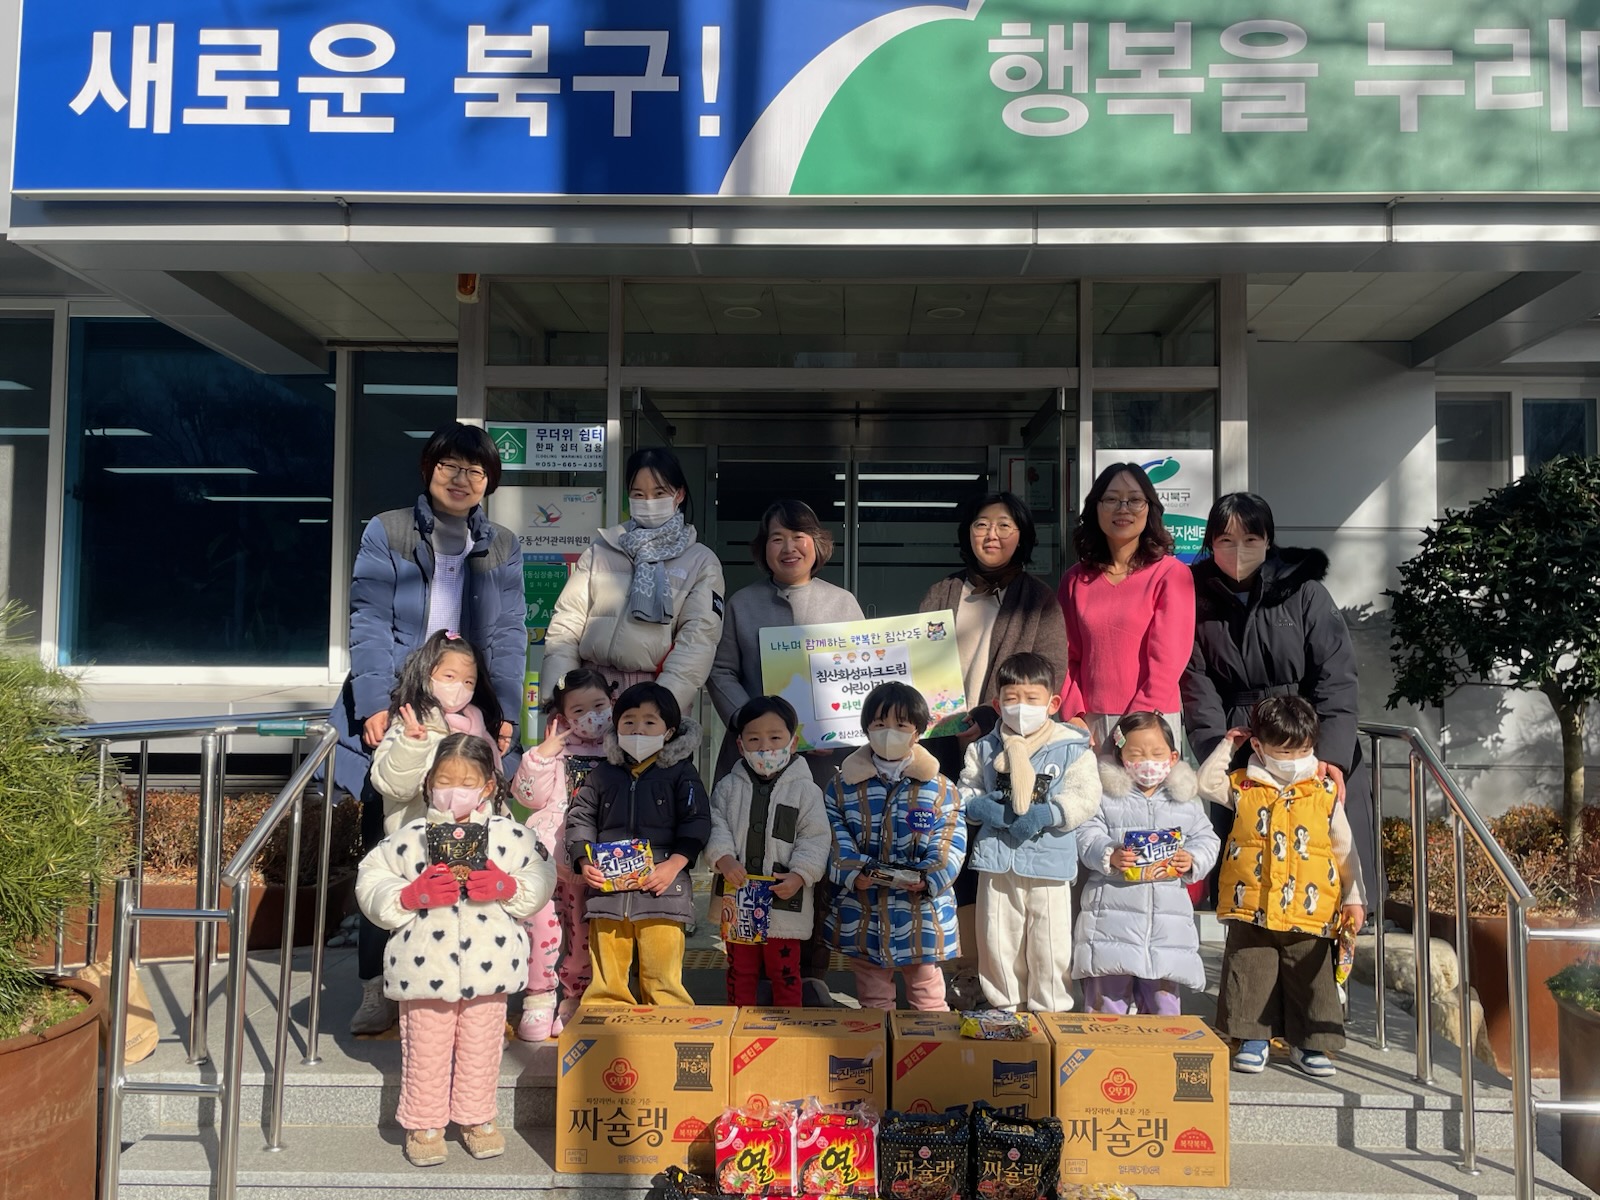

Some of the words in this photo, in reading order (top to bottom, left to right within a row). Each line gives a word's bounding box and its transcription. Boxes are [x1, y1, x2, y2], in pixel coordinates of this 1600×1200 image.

[69, 23, 405, 134] 새로운
[454, 25, 722, 137] 북구!
[988, 20, 1318, 137] 행복을
[535, 428, 573, 441] 무더위
[579, 428, 603, 441] 쉼터
[535, 442, 554, 452] 한파
[560, 443, 578, 452] 쉼터
[770, 640, 802, 652] 나누며
[804, 637, 848, 651] 함께하는
[850, 632, 881, 645] 행복한
[884, 627, 923, 643] 침산2동
[816, 662, 907, 684] 침산화성파크드림
[1108, 1087, 1131, 1097] 오뚜기
[568, 1107, 668, 1148] 짜슐랭
[1067, 1117, 1169, 1158] 짜슐랭
[737, 1147, 775, 1185] 열
[821, 1146, 859, 1184] 열
